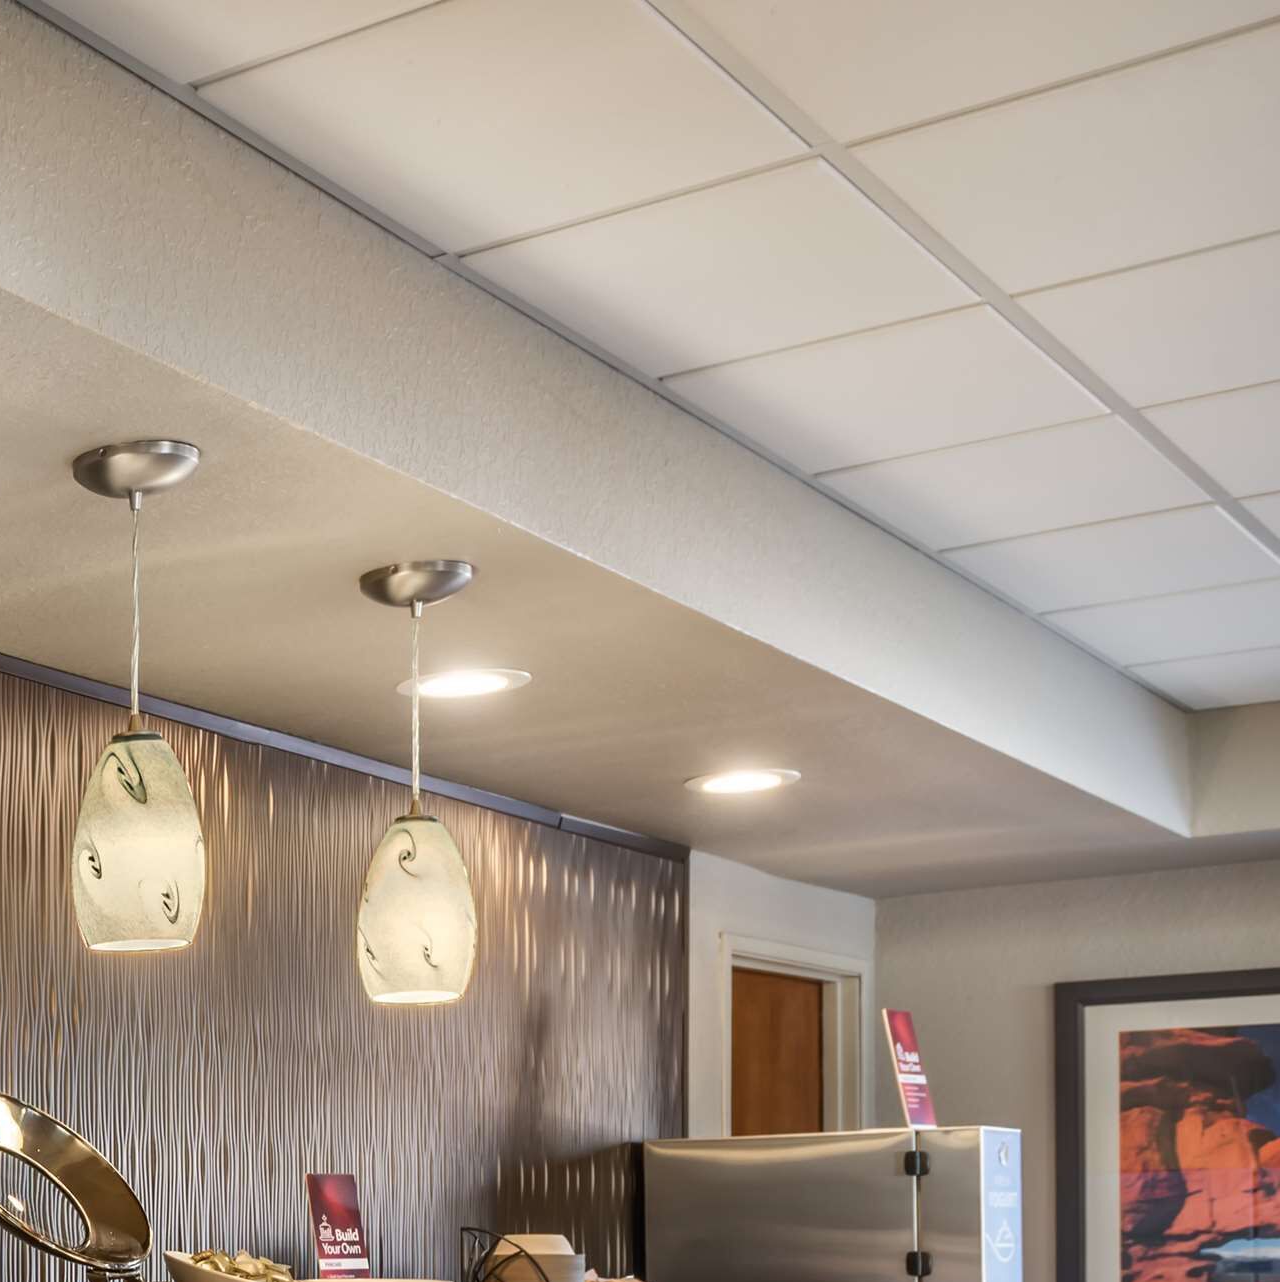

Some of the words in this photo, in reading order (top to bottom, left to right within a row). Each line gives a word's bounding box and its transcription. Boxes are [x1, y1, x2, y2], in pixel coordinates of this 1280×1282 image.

[335, 1228, 359, 1242] Build
[322, 1242, 341, 1255] Your
[342, 1242, 362, 1255] Own
